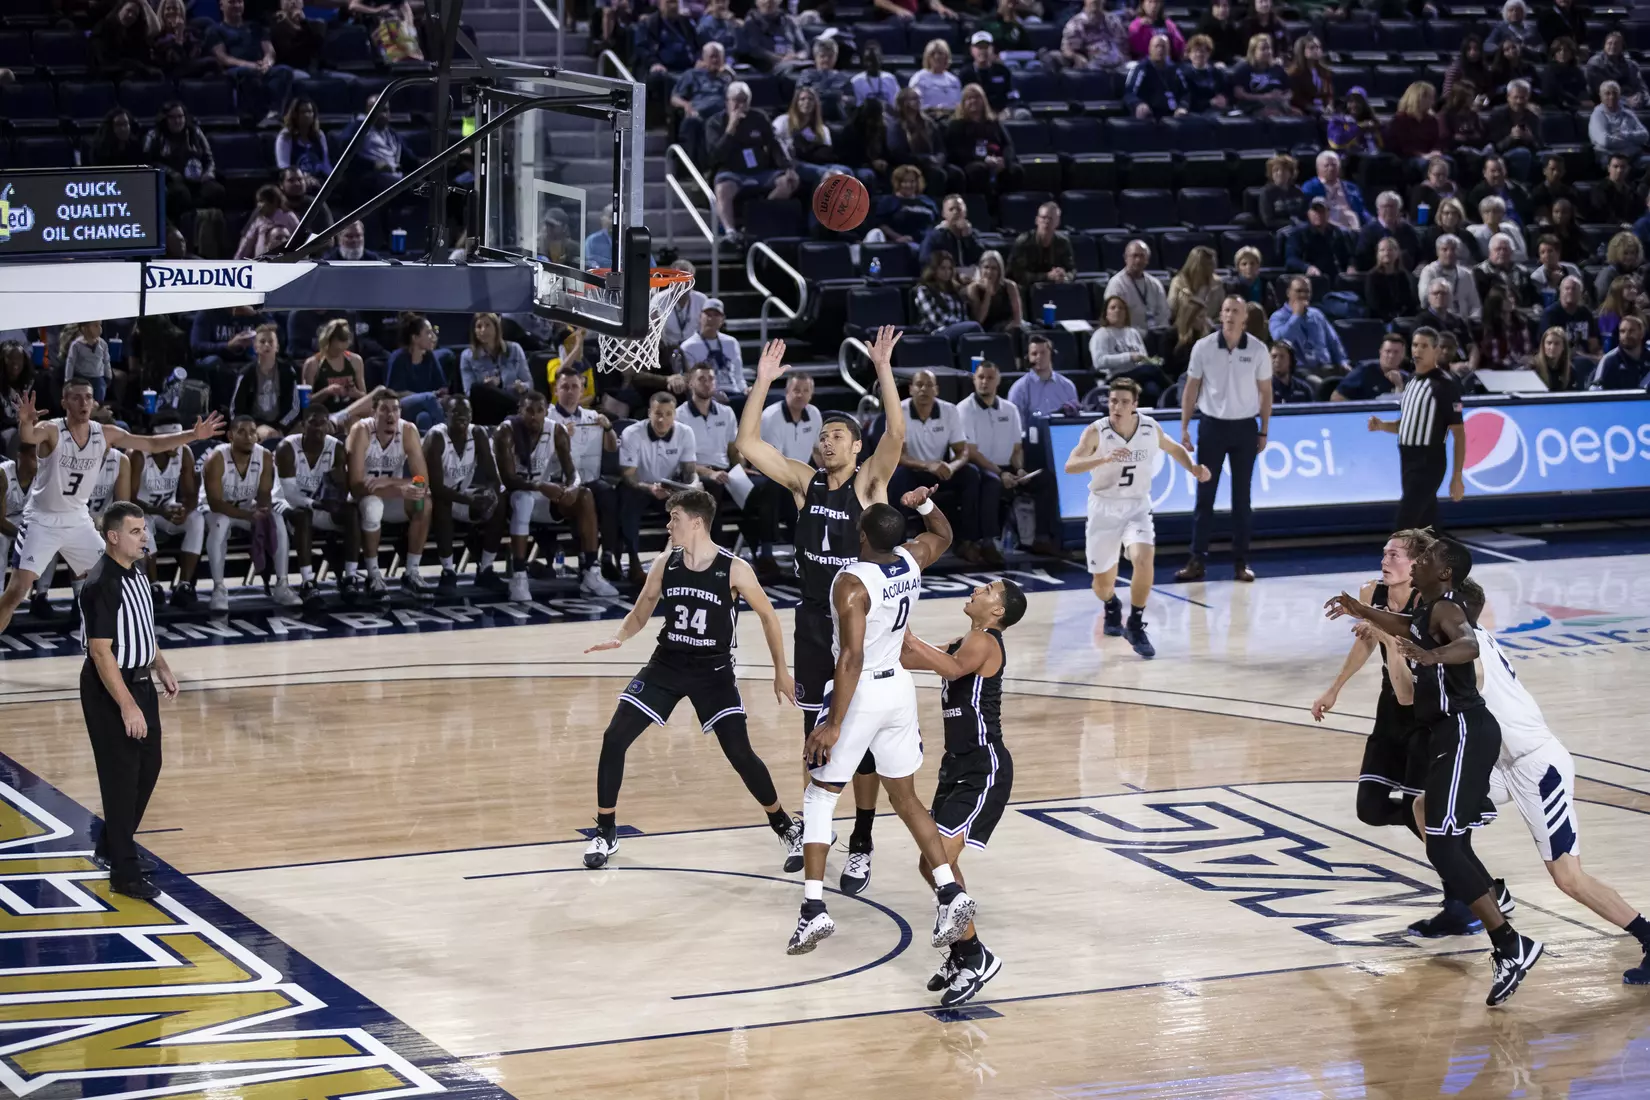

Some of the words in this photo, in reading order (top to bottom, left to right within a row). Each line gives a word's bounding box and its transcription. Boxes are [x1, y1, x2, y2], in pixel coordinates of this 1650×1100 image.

[65, 181, 122, 198] QUICK.
[57, 202, 131, 221] QUALITY.
[42, 226, 70, 242] OIL
[73, 223, 147, 240] CHANGE.
[145, 264, 253, 290] SPALDING
[62, 472, 84, 496] 3
[1118, 465, 1137, 487] 5
[821, 525, 831, 552] 1
[666, 586, 722, 606] CENTRAL
[674, 604, 708, 635] 34
[891, 595, 910, 633] 0
